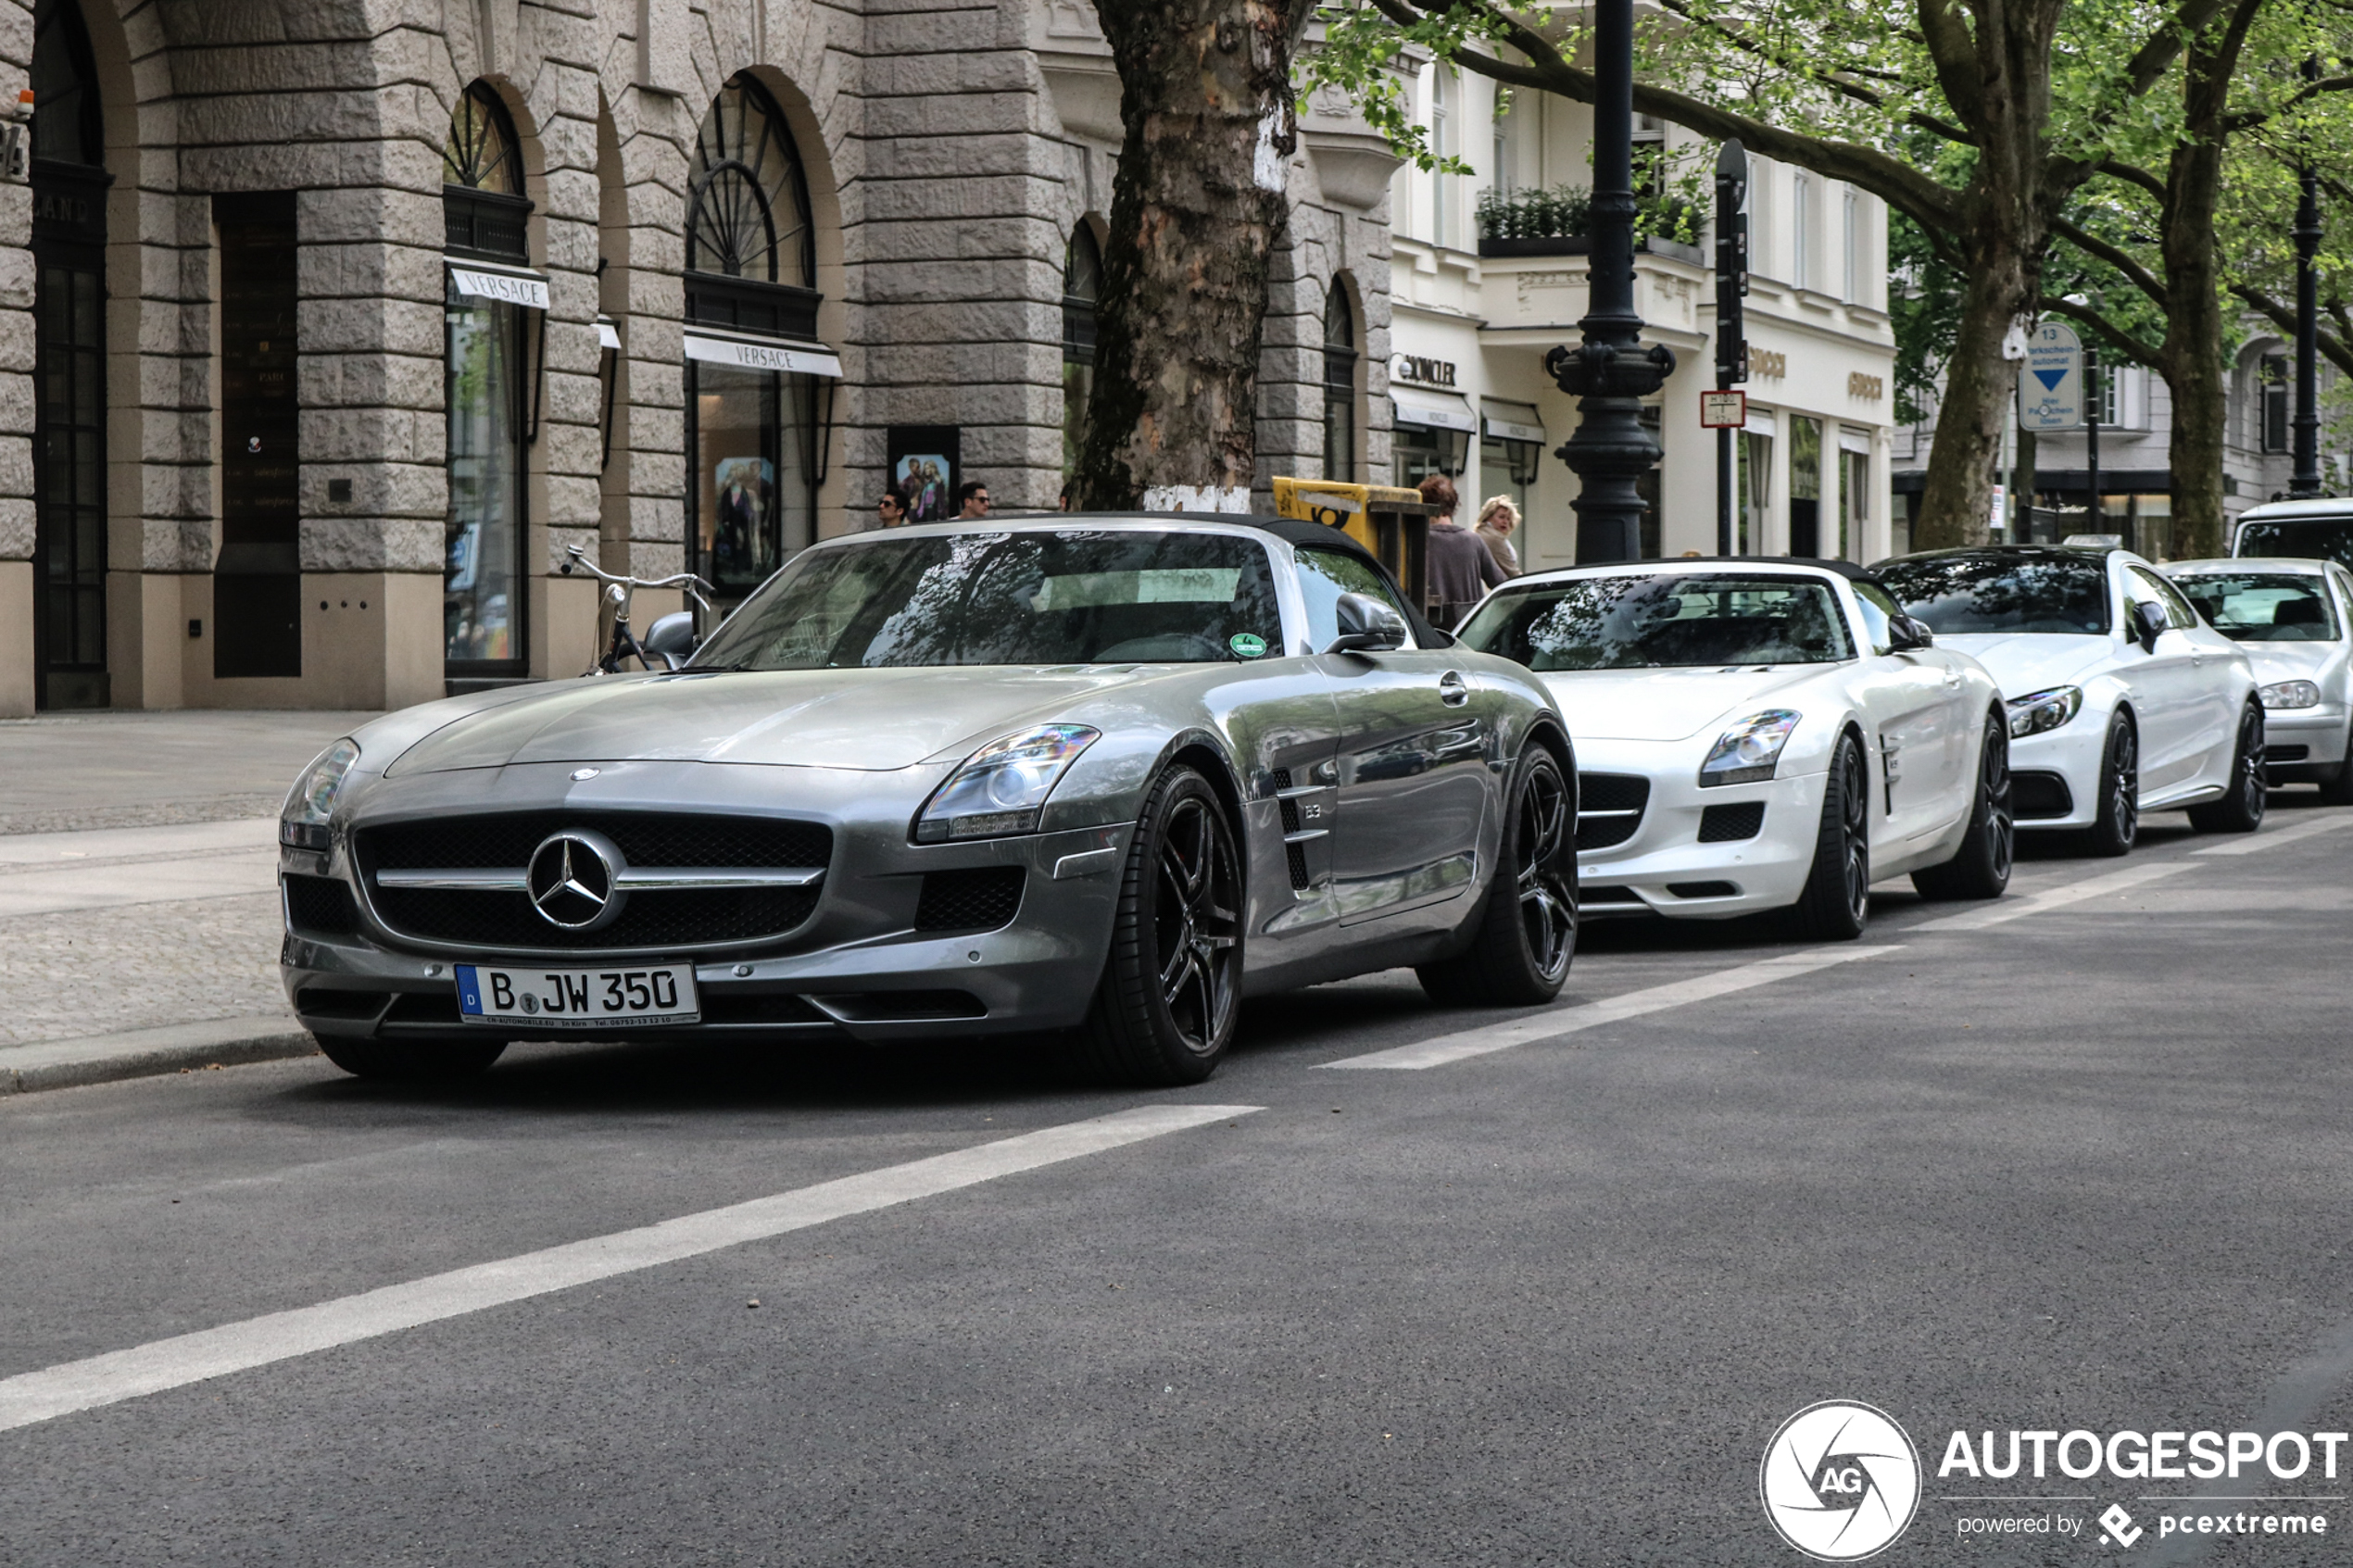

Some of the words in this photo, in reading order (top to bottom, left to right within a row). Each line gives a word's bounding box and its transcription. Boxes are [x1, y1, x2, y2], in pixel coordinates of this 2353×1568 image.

[464, 273, 539, 304] VERSACE
[2043, 329, 2057, 340] 13
[736, 345, 794, 369] VERSACE
[2032, 357, 2069, 365] automat
[1848, 370, 1882, 400] GUCCI
[1242, 635, 1252, 645] 4
[467, 994, 475, 1006] D
[490, 972, 516, 1010] B
[542, 973, 589, 1012] JW
[599, 970, 678, 1011] 350
